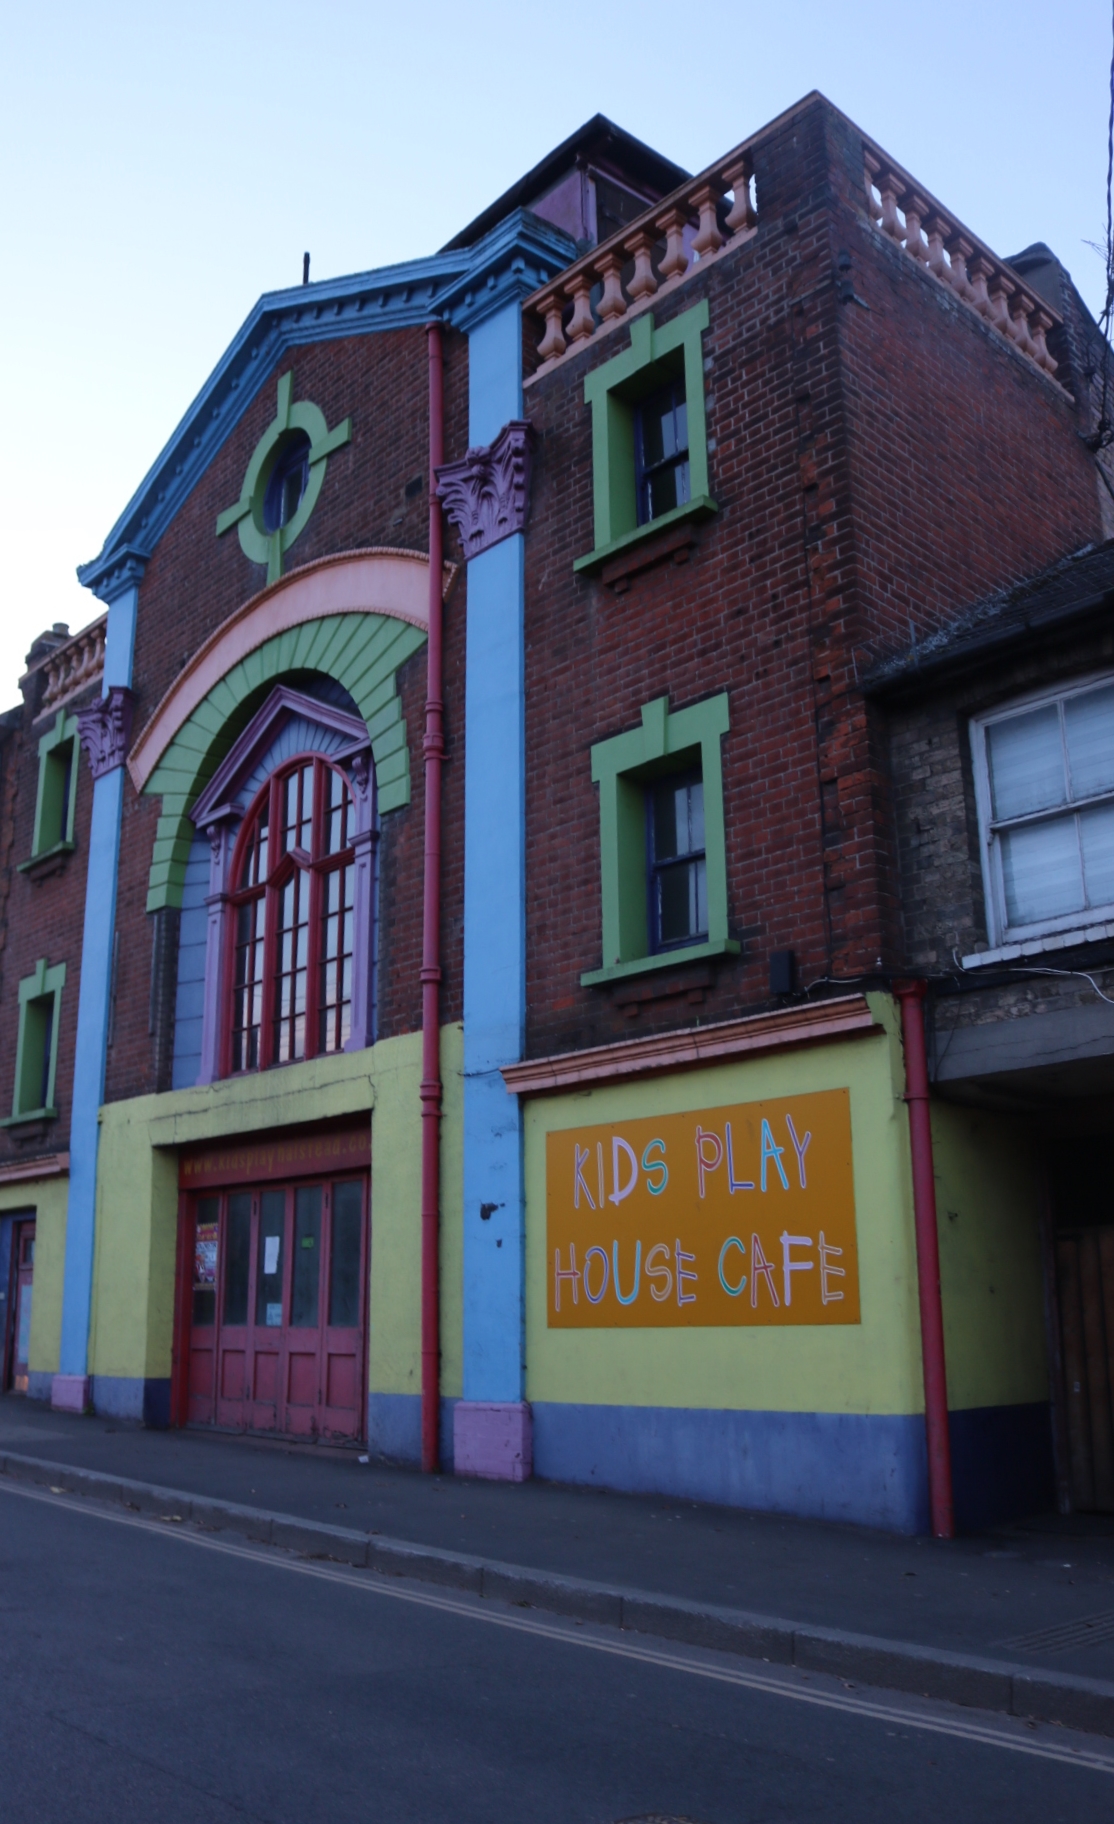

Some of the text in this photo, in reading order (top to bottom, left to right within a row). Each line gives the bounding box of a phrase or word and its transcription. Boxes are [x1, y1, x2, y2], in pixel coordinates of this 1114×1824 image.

[574, 1114, 811, 1210] KIDS PLAY
[555, 1231, 845, 1312] HOUSE CAFE
